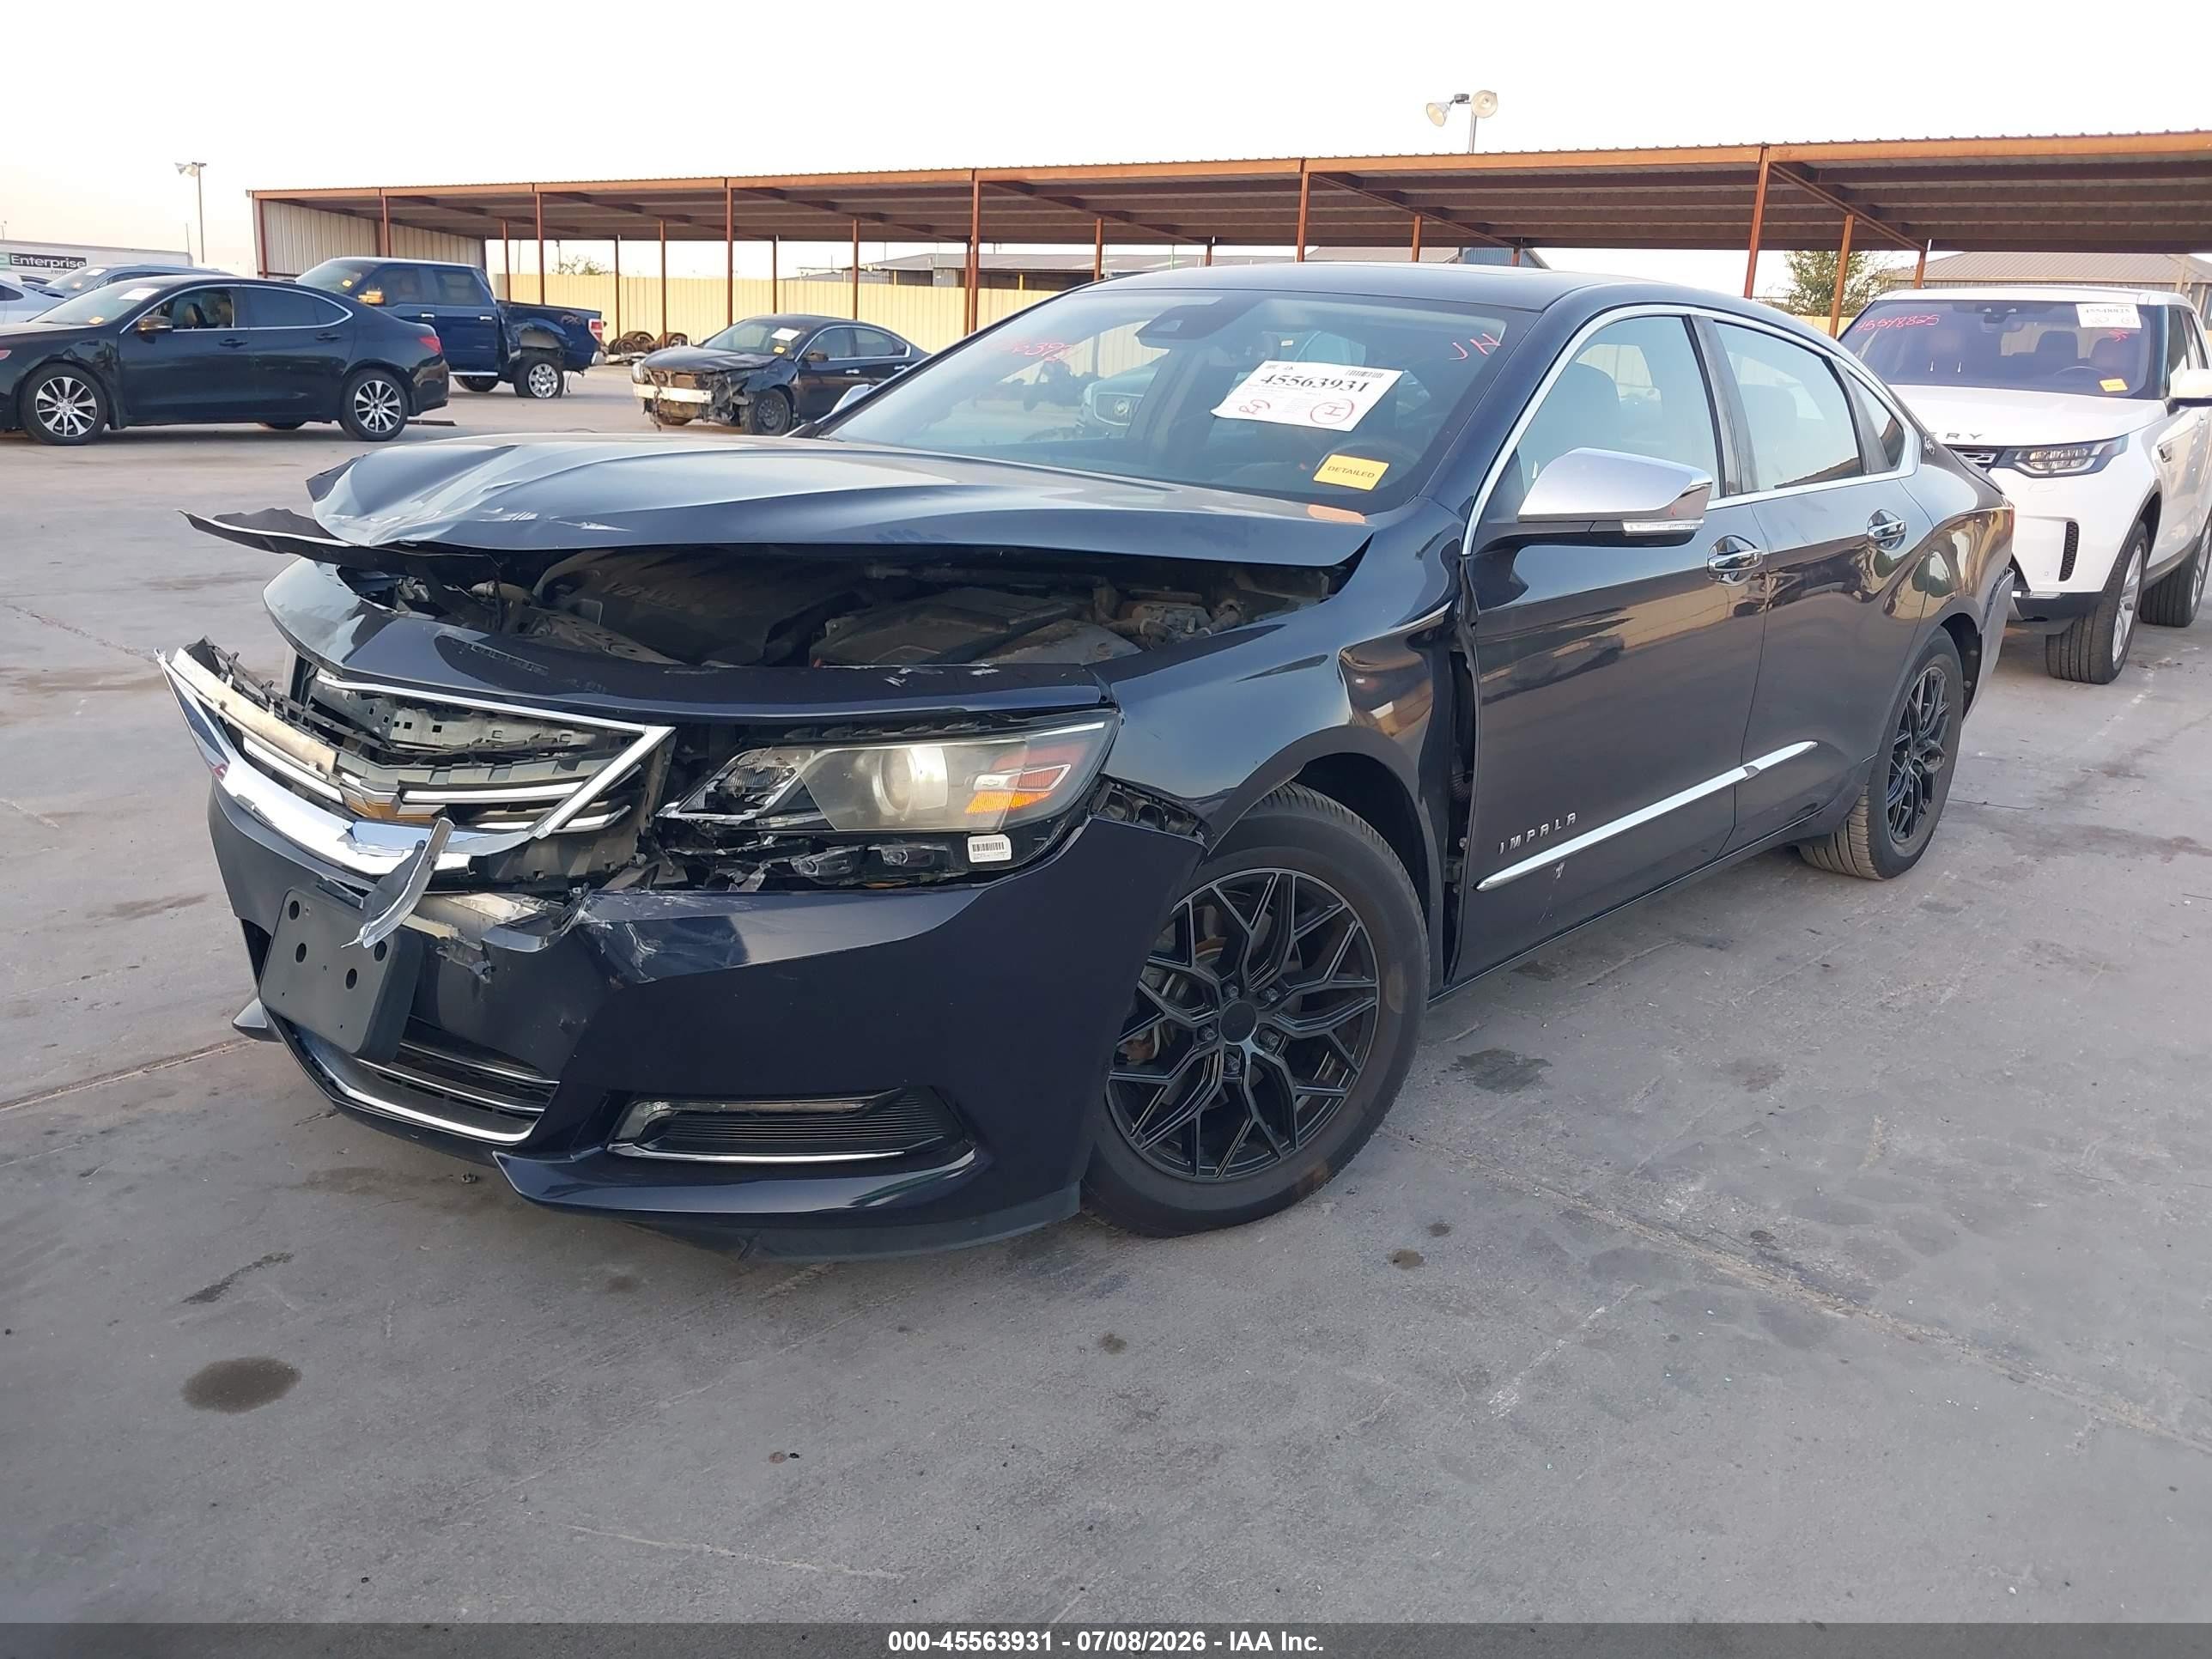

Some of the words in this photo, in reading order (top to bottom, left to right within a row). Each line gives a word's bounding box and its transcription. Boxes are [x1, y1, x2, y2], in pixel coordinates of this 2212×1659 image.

[11, 254, 86, 268] Enterprise
[1261, 374, 1370, 392] 45563931
[1327, 465, 1375, 478] DETAILED
[1499, 812, 1577, 854] IMPALA
